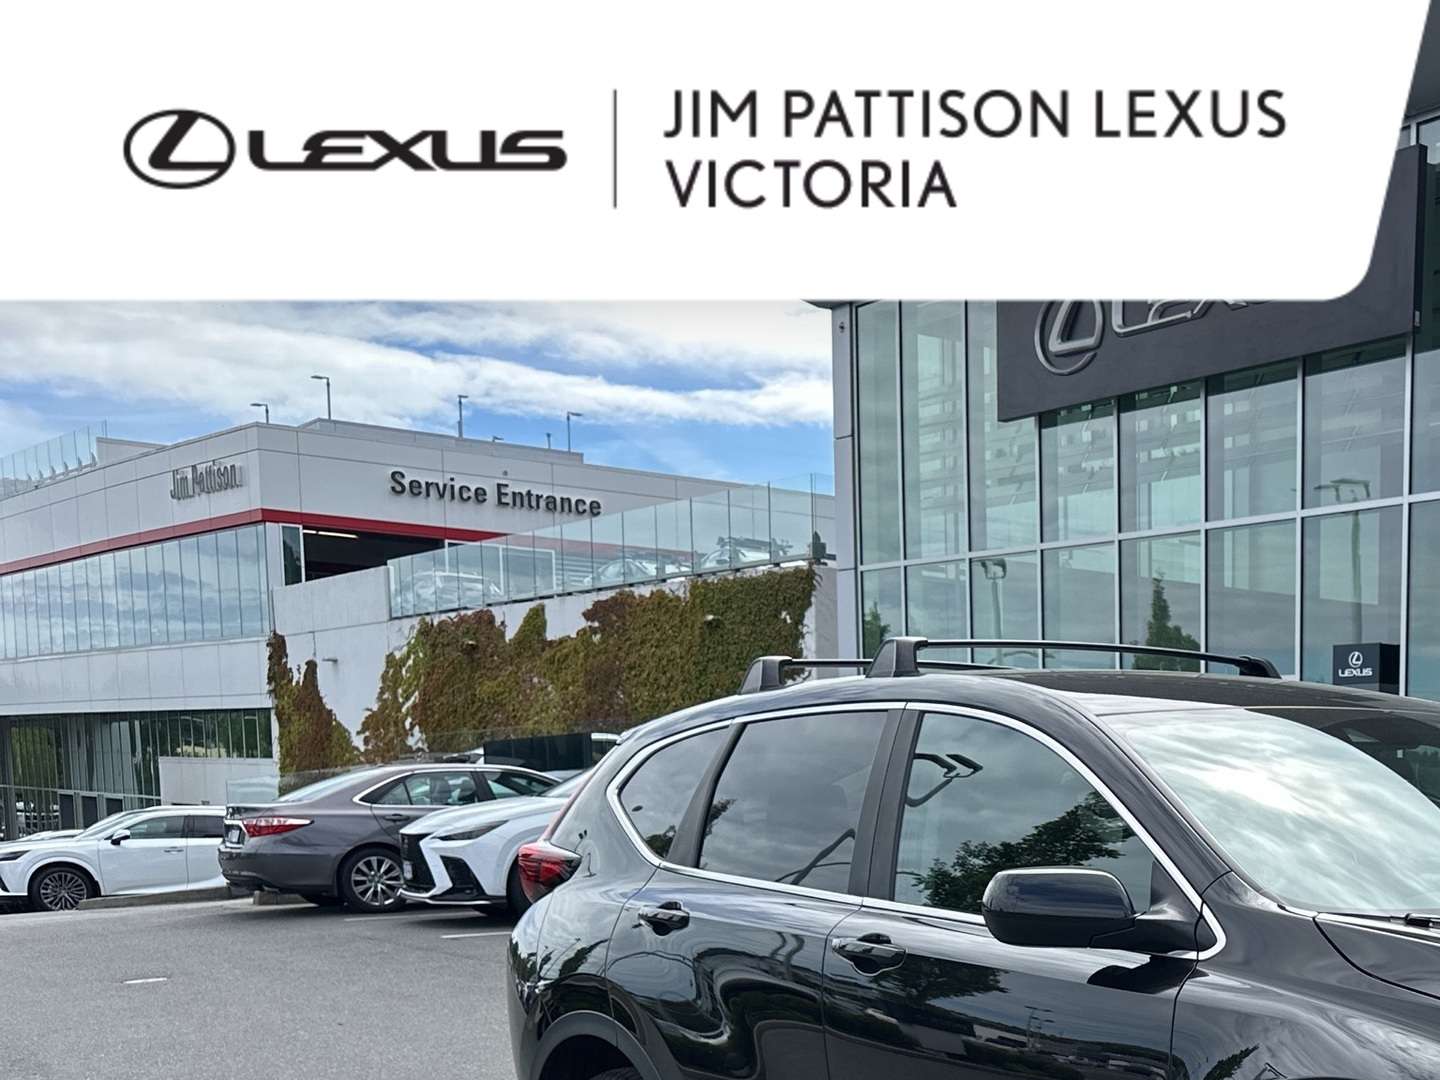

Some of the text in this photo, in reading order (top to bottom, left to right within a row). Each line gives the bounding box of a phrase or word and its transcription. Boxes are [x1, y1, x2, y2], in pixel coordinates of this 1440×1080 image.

[170, 469, 190, 500] Jim
[390, 470, 602, 517] Service Entrance
[1338, 667, 1373, 677] LEXUS
